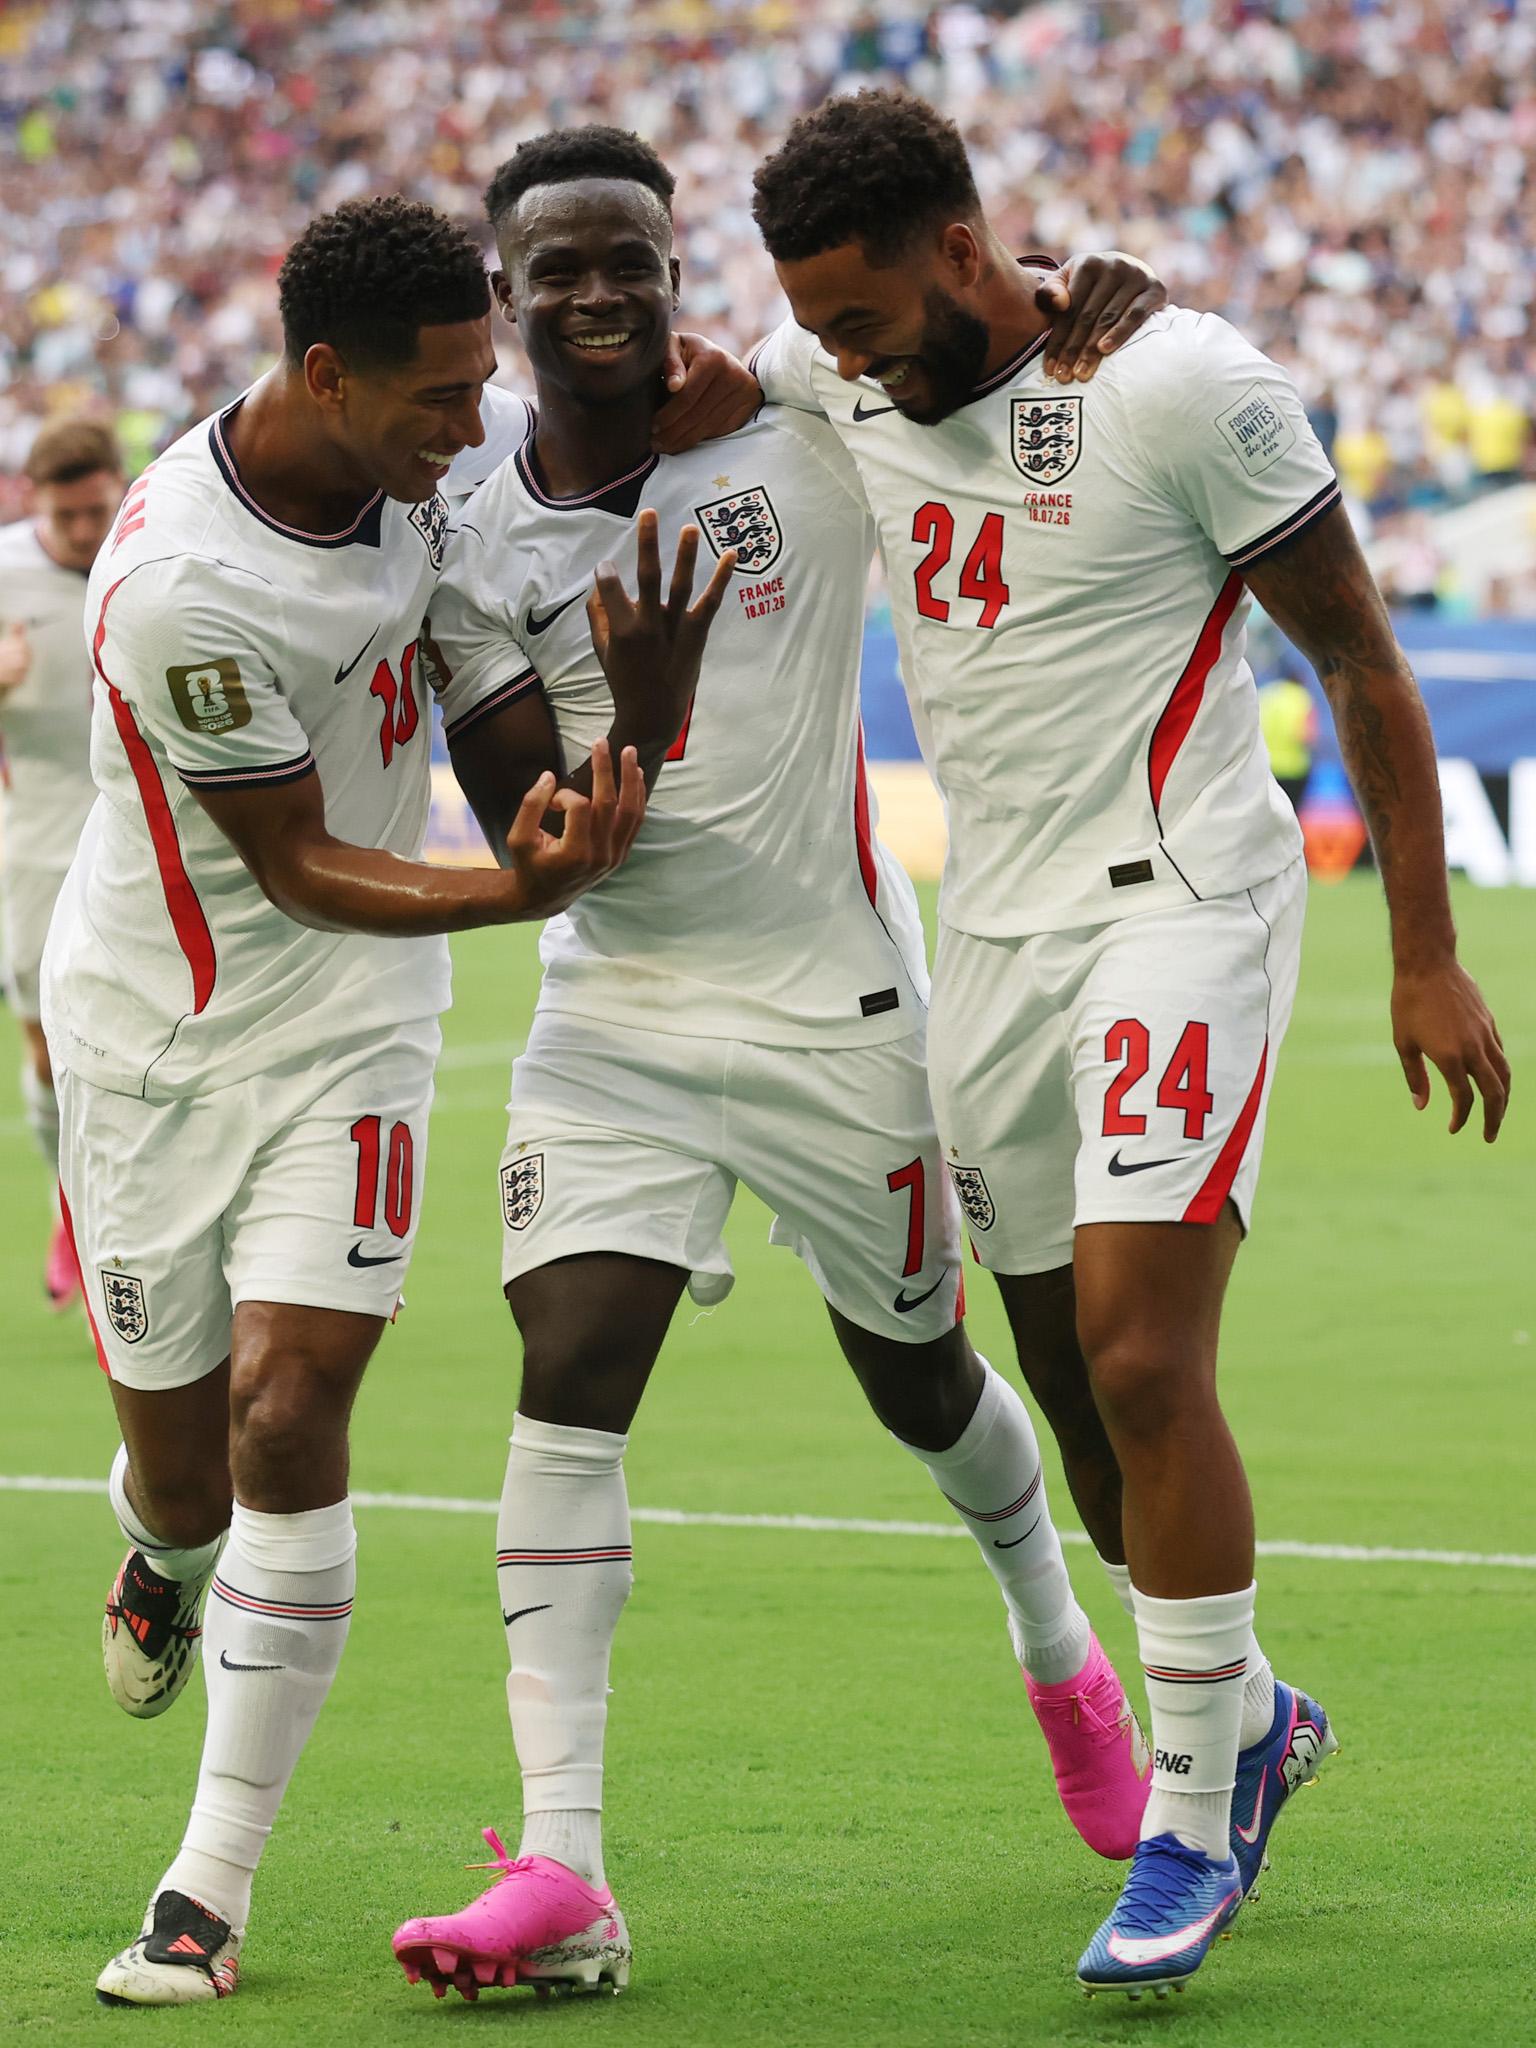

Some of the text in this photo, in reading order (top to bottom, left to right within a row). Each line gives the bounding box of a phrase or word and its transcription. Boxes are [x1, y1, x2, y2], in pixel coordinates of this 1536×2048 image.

[1228, 396, 1266, 430] FOOTBALL
[1235, 405, 1275, 444] UNITES
[1243, 417, 1285, 458] the World
[1263, 442, 1280, 457] FIFA
[1023, 493, 1073, 508] FRANCE
[1028, 507, 1070, 525] 18.07.26
[912, 501, 1010, 629] 24
[738, 576, 785, 603] FRANCE
[744, 595, 786, 620] 18.07.26
[369, 637, 419, 770] 10
[200, 718, 234, 731] 2026
[1101, 1018, 1214, 1141] 24
[350, 1114, 414, 1240] 10
[886, 1155, 926, 1279] 7
[1155, 1748, 1193, 1775] ENG
